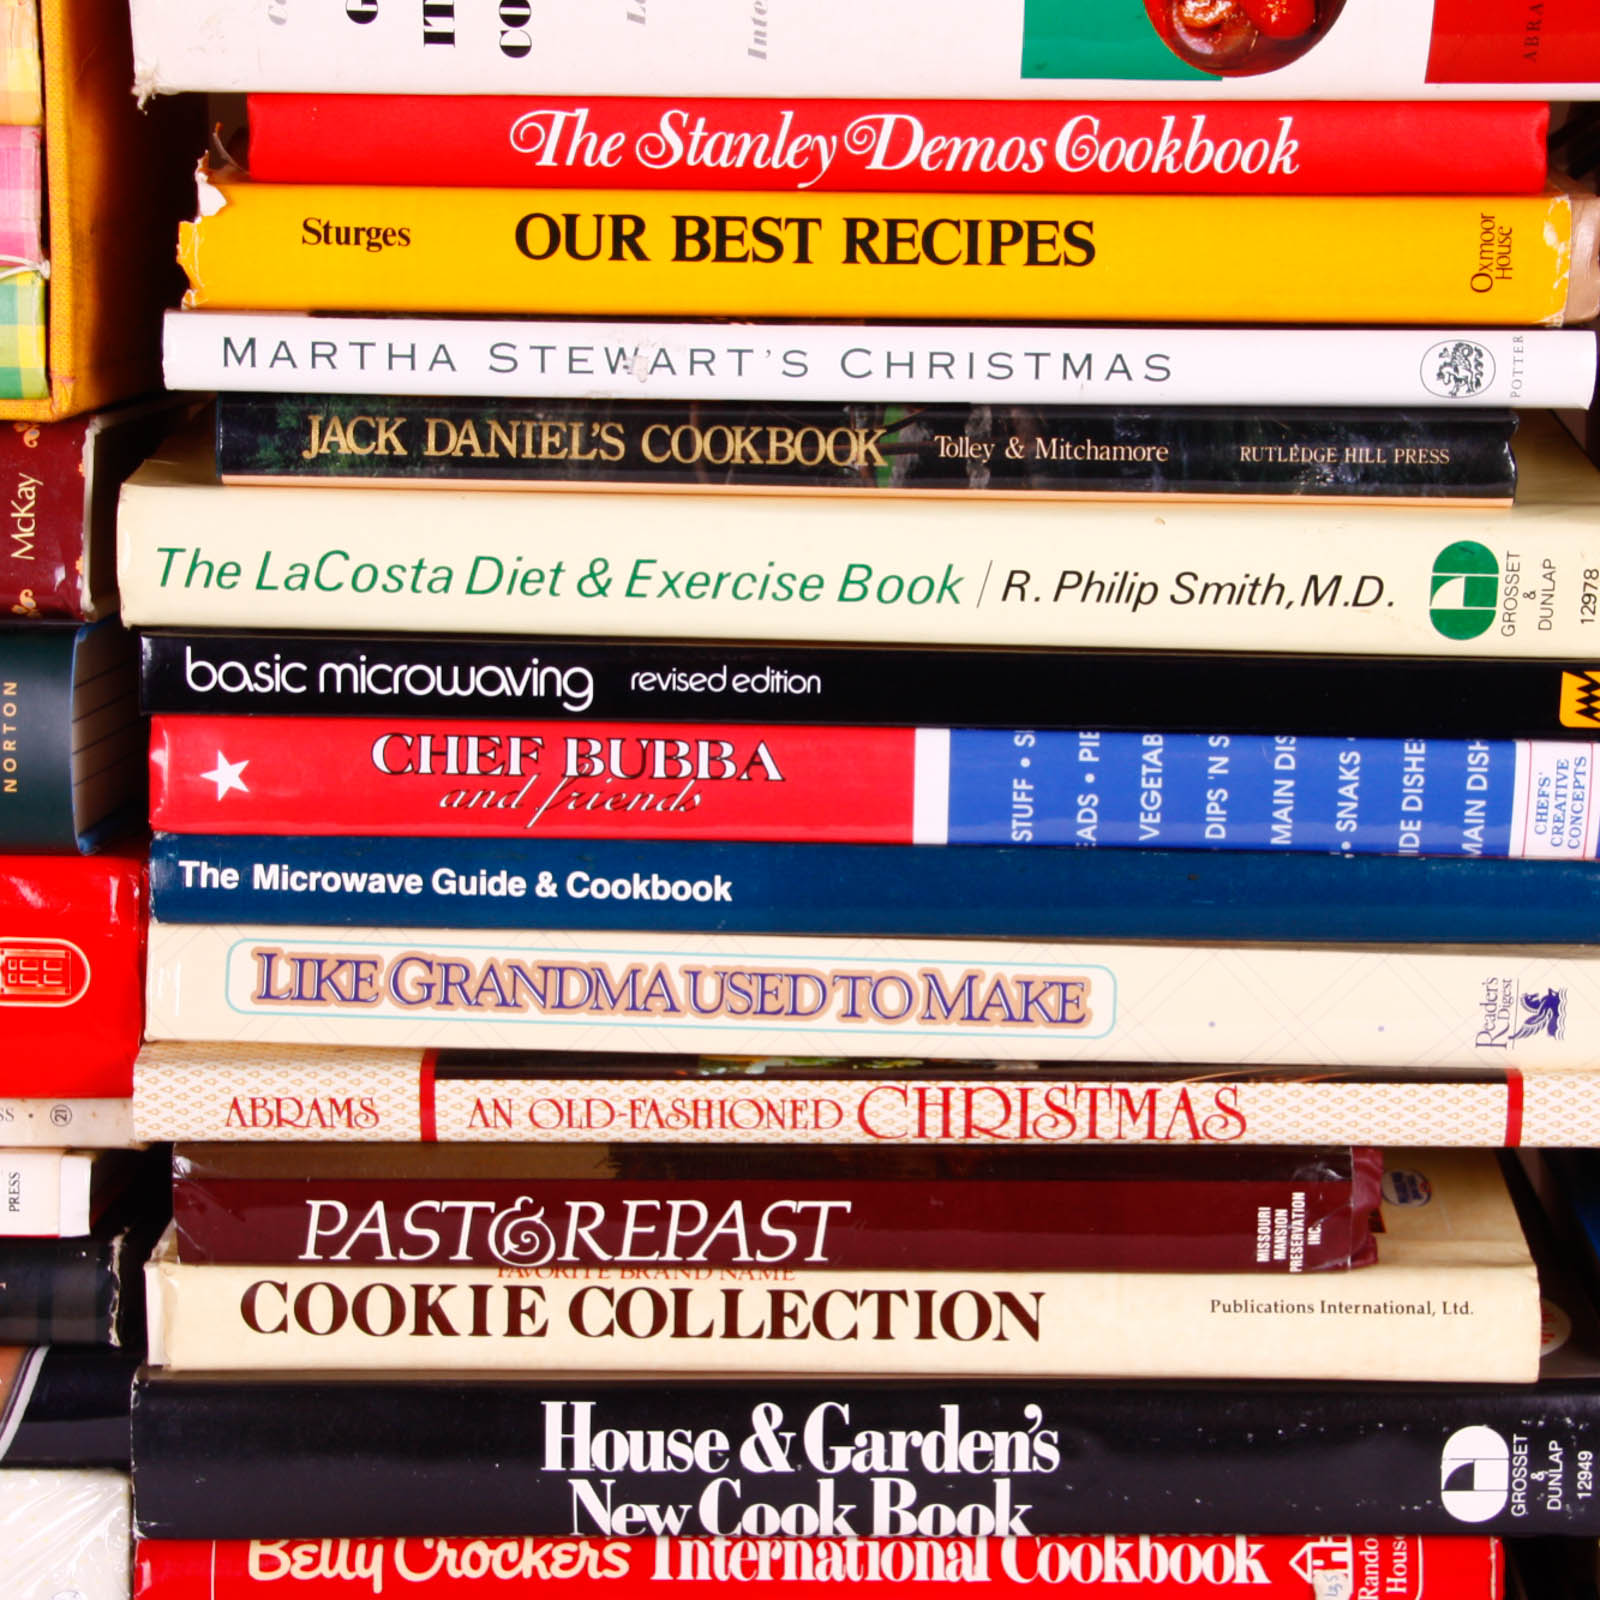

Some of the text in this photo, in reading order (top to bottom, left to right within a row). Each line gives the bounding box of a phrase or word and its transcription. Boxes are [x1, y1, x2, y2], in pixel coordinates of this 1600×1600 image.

[510, 108, 1300, 189] The Stanley Demos Cookbook
[301, 217, 411, 252] Sturges
[515, 213, 1096, 268] OUR BEST RECIPES
[1470, 212, 1495, 293] Oxmoor
[1495, 226, 1513, 280] House
[222, 335, 1173, 382] MARTHA STEWART'S CHRISTMAS
[1510, 336, 1524, 398] POTTER
[303, 415, 889, 468] JACK DANIEL'S COOKBOOK
[934, 435, 1169, 464] Tolley & Mitchamore
[1240, 445, 1451, 466] RUTLEDGE HILL PRESS
[10, 472, 44, 560] McKay
[155, 547, 964, 605] The LaCosta Diet & Exercise Book
[1001, 569, 1042, 603] R.
[1053, 570, 1159, 612] Philip
[1501, 550, 1520, 637] GROSSET
[1522, 590, 1537, 600] &
[1538, 558, 1556, 631] DUNLAP
[1580, 568, 1600, 625] 12978
[185, 646, 821, 711] basic microwaving revised edition
[3, 681, 18, 793] NORTON
[371, 732, 786, 781] CHEF BUBBA
[438, 763, 702, 829] and friends
[1011, 778, 1034, 842] STUFF
[1139, 734, 1163, 841] VEGETAB
[1205, 788, 1229, 839] DIPS
[1270, 779, 1295, 844] MAIN
[1336, 751, 1361, 832] SNAKS
[1551, 758, 1569, 847] CREATIVE
[1568, 756, 1587, 849] CONCEPTS
[178, 860, 733, 902] The Microwave Guide & Cookbook
[255, 951, 1087, 1025] LIKE GRANDMA USED TO MAKE
[1475, 976, 1509, 1048] Reader's
[1497, 978, 1513, 1020] Digest
[225, 1096, 380, 1129] ABRAMS
[467, 1083, 1248, 1141] AN OLD-FASHIONED CHRISTMAS
[8, 1172, 20, 1212] PRESS
[1257, 1206, 1271, 1262] MISSOURI
[1273, 1208, 1288, 1260] MANSION
[1289, 1192, 1305, 1273] PRESERVATION
[1307, 1223, 1322, 1245] INC.
[239, 1279, 1047, 1343] COOKIE COLLECTION
[1210, 1299, 1474, 1317] Publications International, Ltd.
[541, 1400, 1061, 1475] House & Garden's
[1511, 1433, 1528, 1516] GROSSET
[1530, 1471, 1545, 1481] &
[1547, 1440, 1563, 1510] DUNLAP
[1577, 1451, 1593, 1499] 12949
[568, 1477, 1034, 1537] New Cook Book
[650, 1536, 992, 1582] International
[1001, 1535, 1272, 1584] Cookbook
